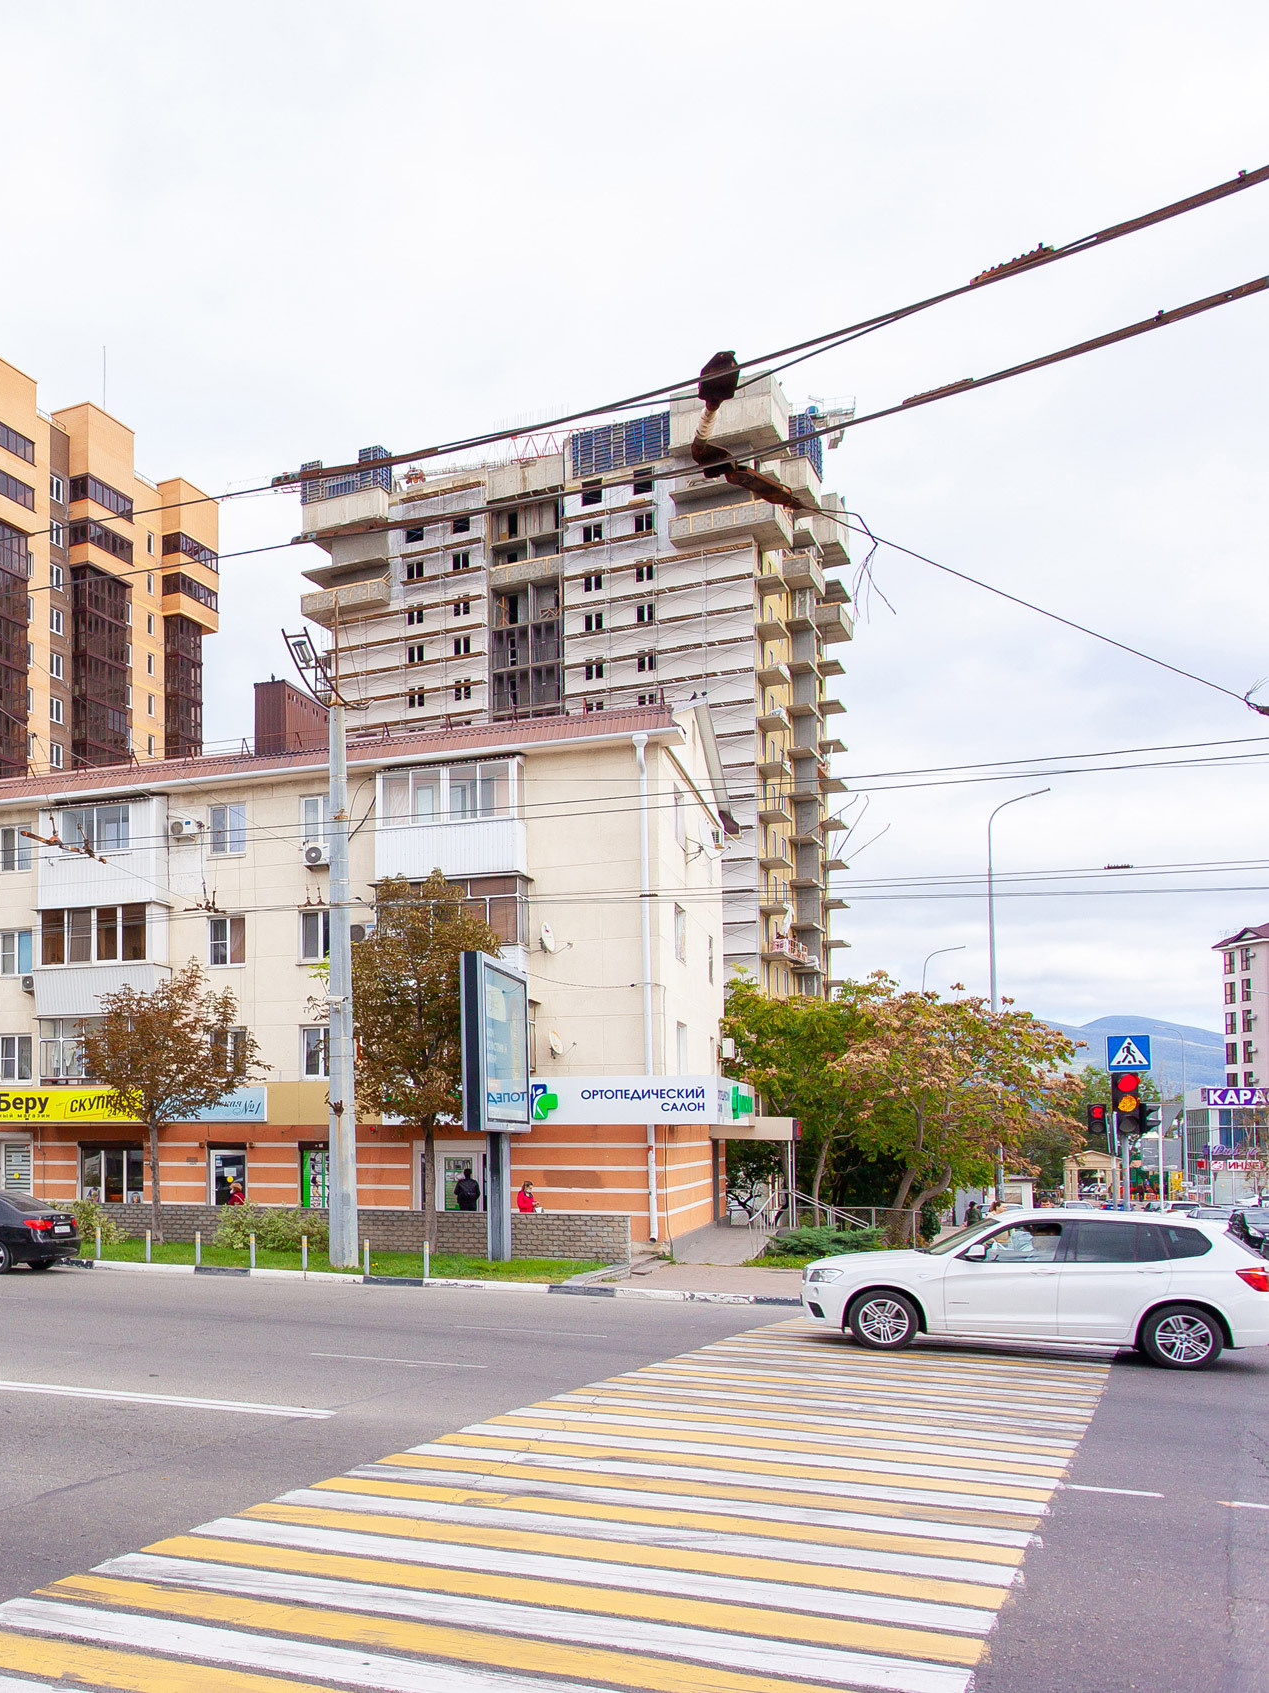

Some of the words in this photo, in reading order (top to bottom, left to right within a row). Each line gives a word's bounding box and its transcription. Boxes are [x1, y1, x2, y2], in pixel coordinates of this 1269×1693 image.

[580, 1086, 705, 1101] ОРТОПЕДИЧЕСКИЙ
[1209, 1090, 1269, 1104] КАРА
[661, 1102, 705, 1111] САЛОН
